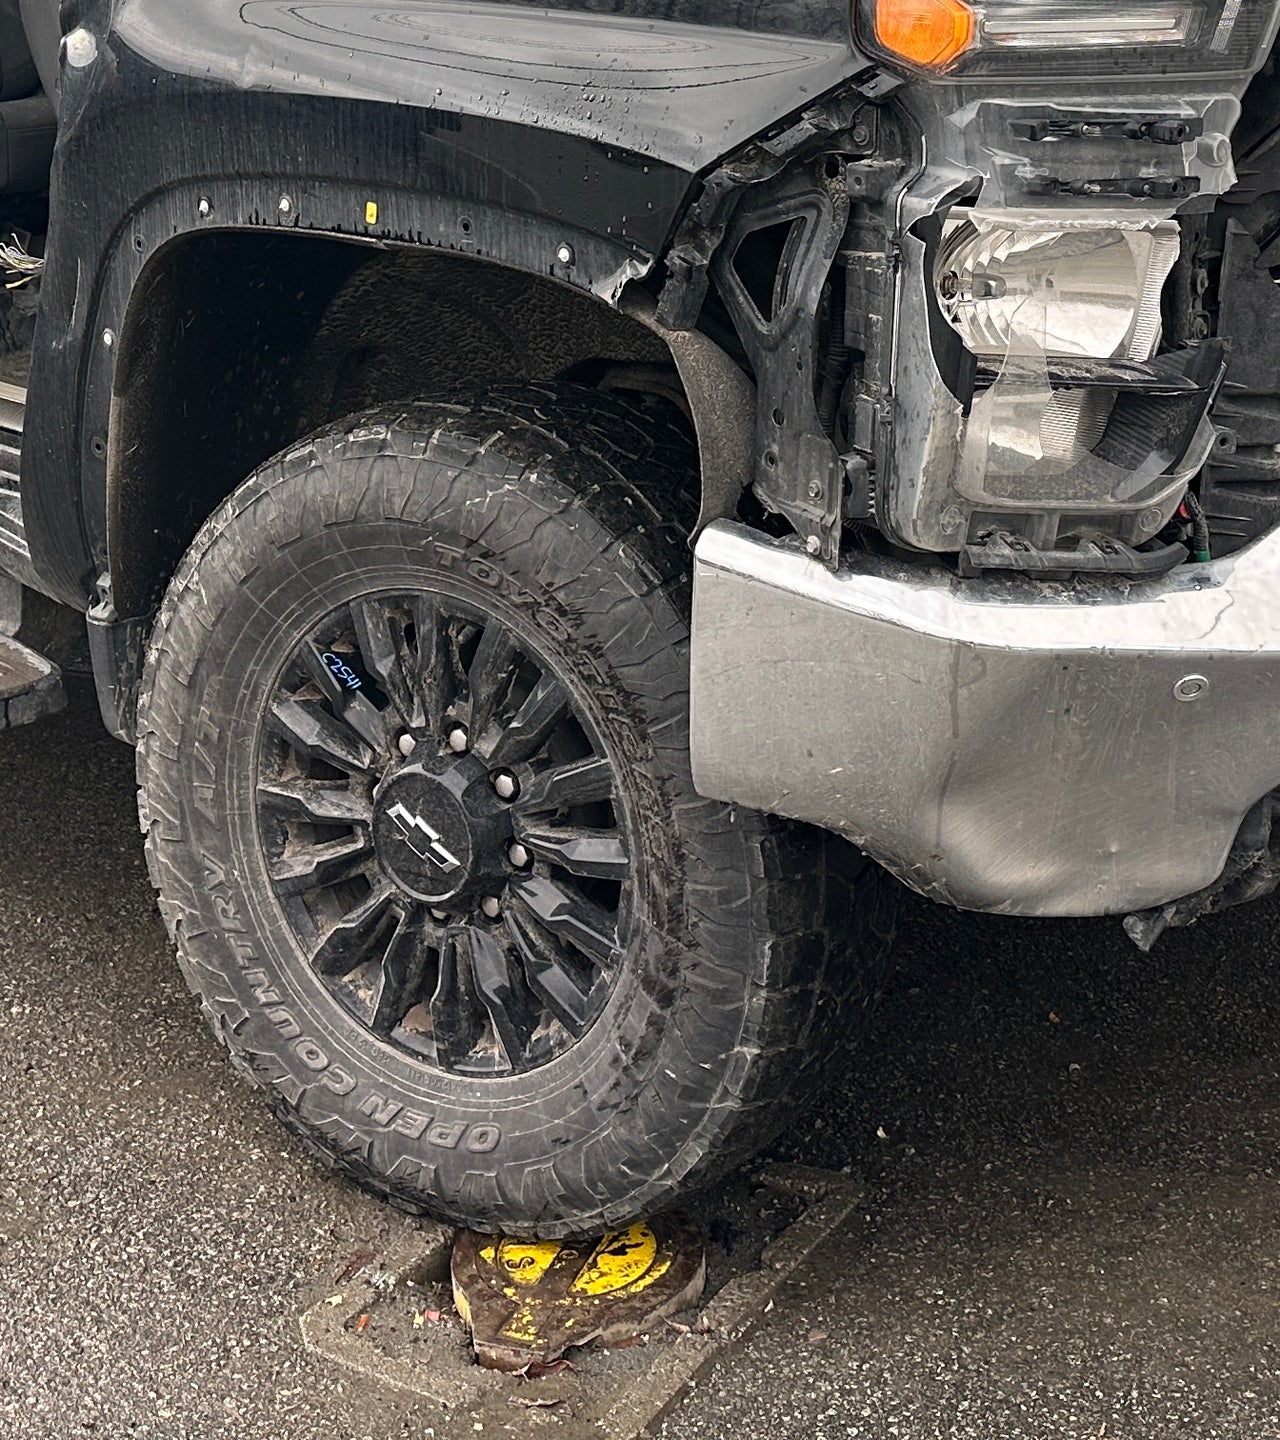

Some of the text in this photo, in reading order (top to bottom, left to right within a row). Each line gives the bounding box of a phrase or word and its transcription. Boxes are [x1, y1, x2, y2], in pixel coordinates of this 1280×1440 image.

[321, 652, 362, 690] C2541
[200, 850, 358, 1097] COUNTRY
[356, 1089, 503, 1155] OPEN
